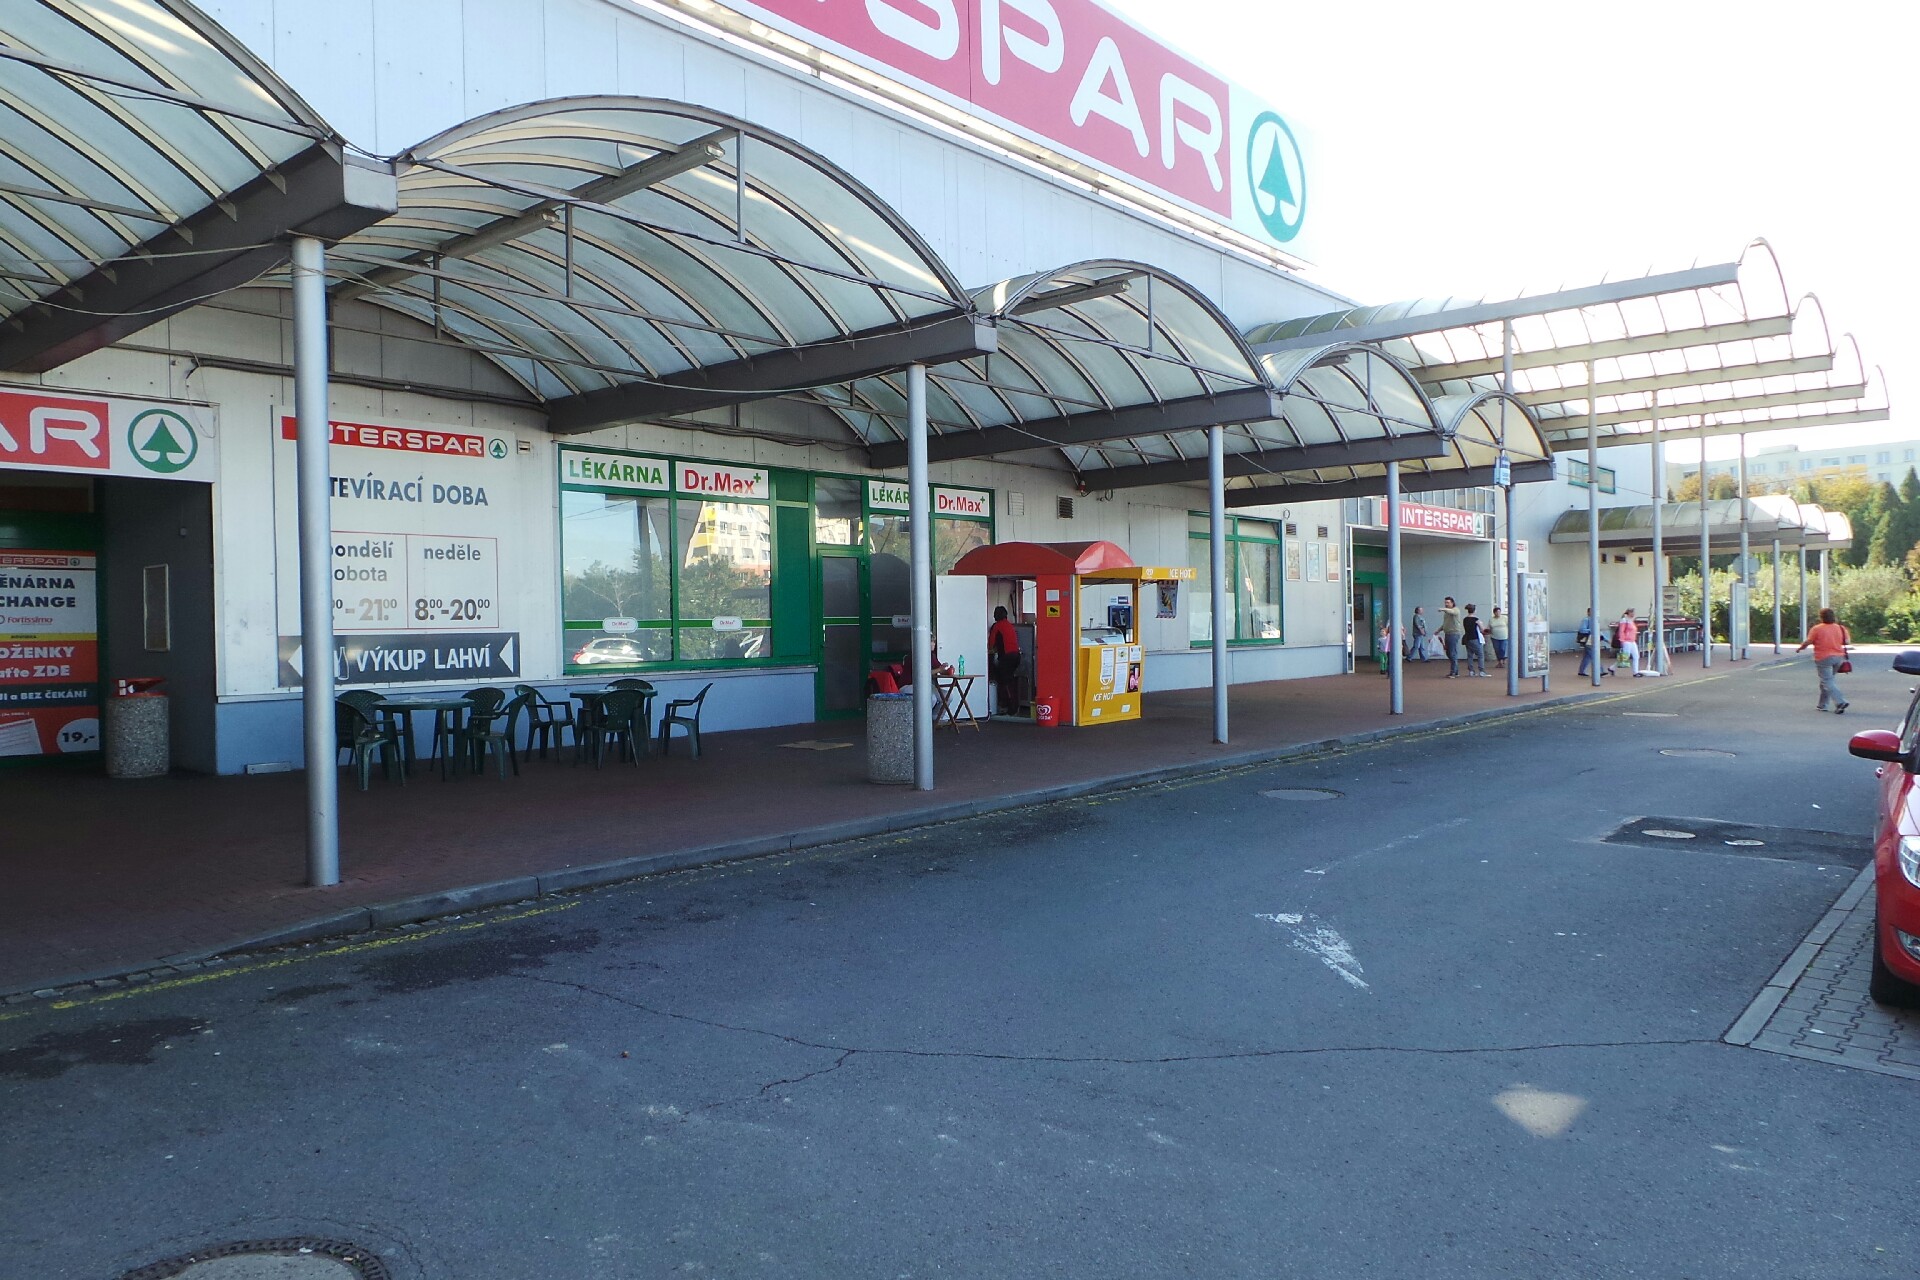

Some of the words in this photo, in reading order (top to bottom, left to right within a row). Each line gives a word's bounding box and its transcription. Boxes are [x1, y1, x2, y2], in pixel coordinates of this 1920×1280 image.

[329, 425, 483, 454] TERSPAR
[569, 457, 664, 485] LÉKÁRNA
[433, 484, 489, 506] DOBA
[1402, 507, 1473, 531] INTERSPAR
[331, 541, 394, 559] ondělí
[424, 544, 481, 561] neděle
[333, 566, 387, 582] obota
[1169, 568, 1179, 578] ICE
[1180, 568, 1192, 579] HOT
[357, 646, 426, 672] VÝKUP
[434, 643, 491, 669] LAHVÍ
[33, 665, 70, 677] ZDE
[20, 692, 42, 700] BEZ
[45, 690, 88, 699] ČEKÁNÍ
[62, 731, 95, 744] 19,-
